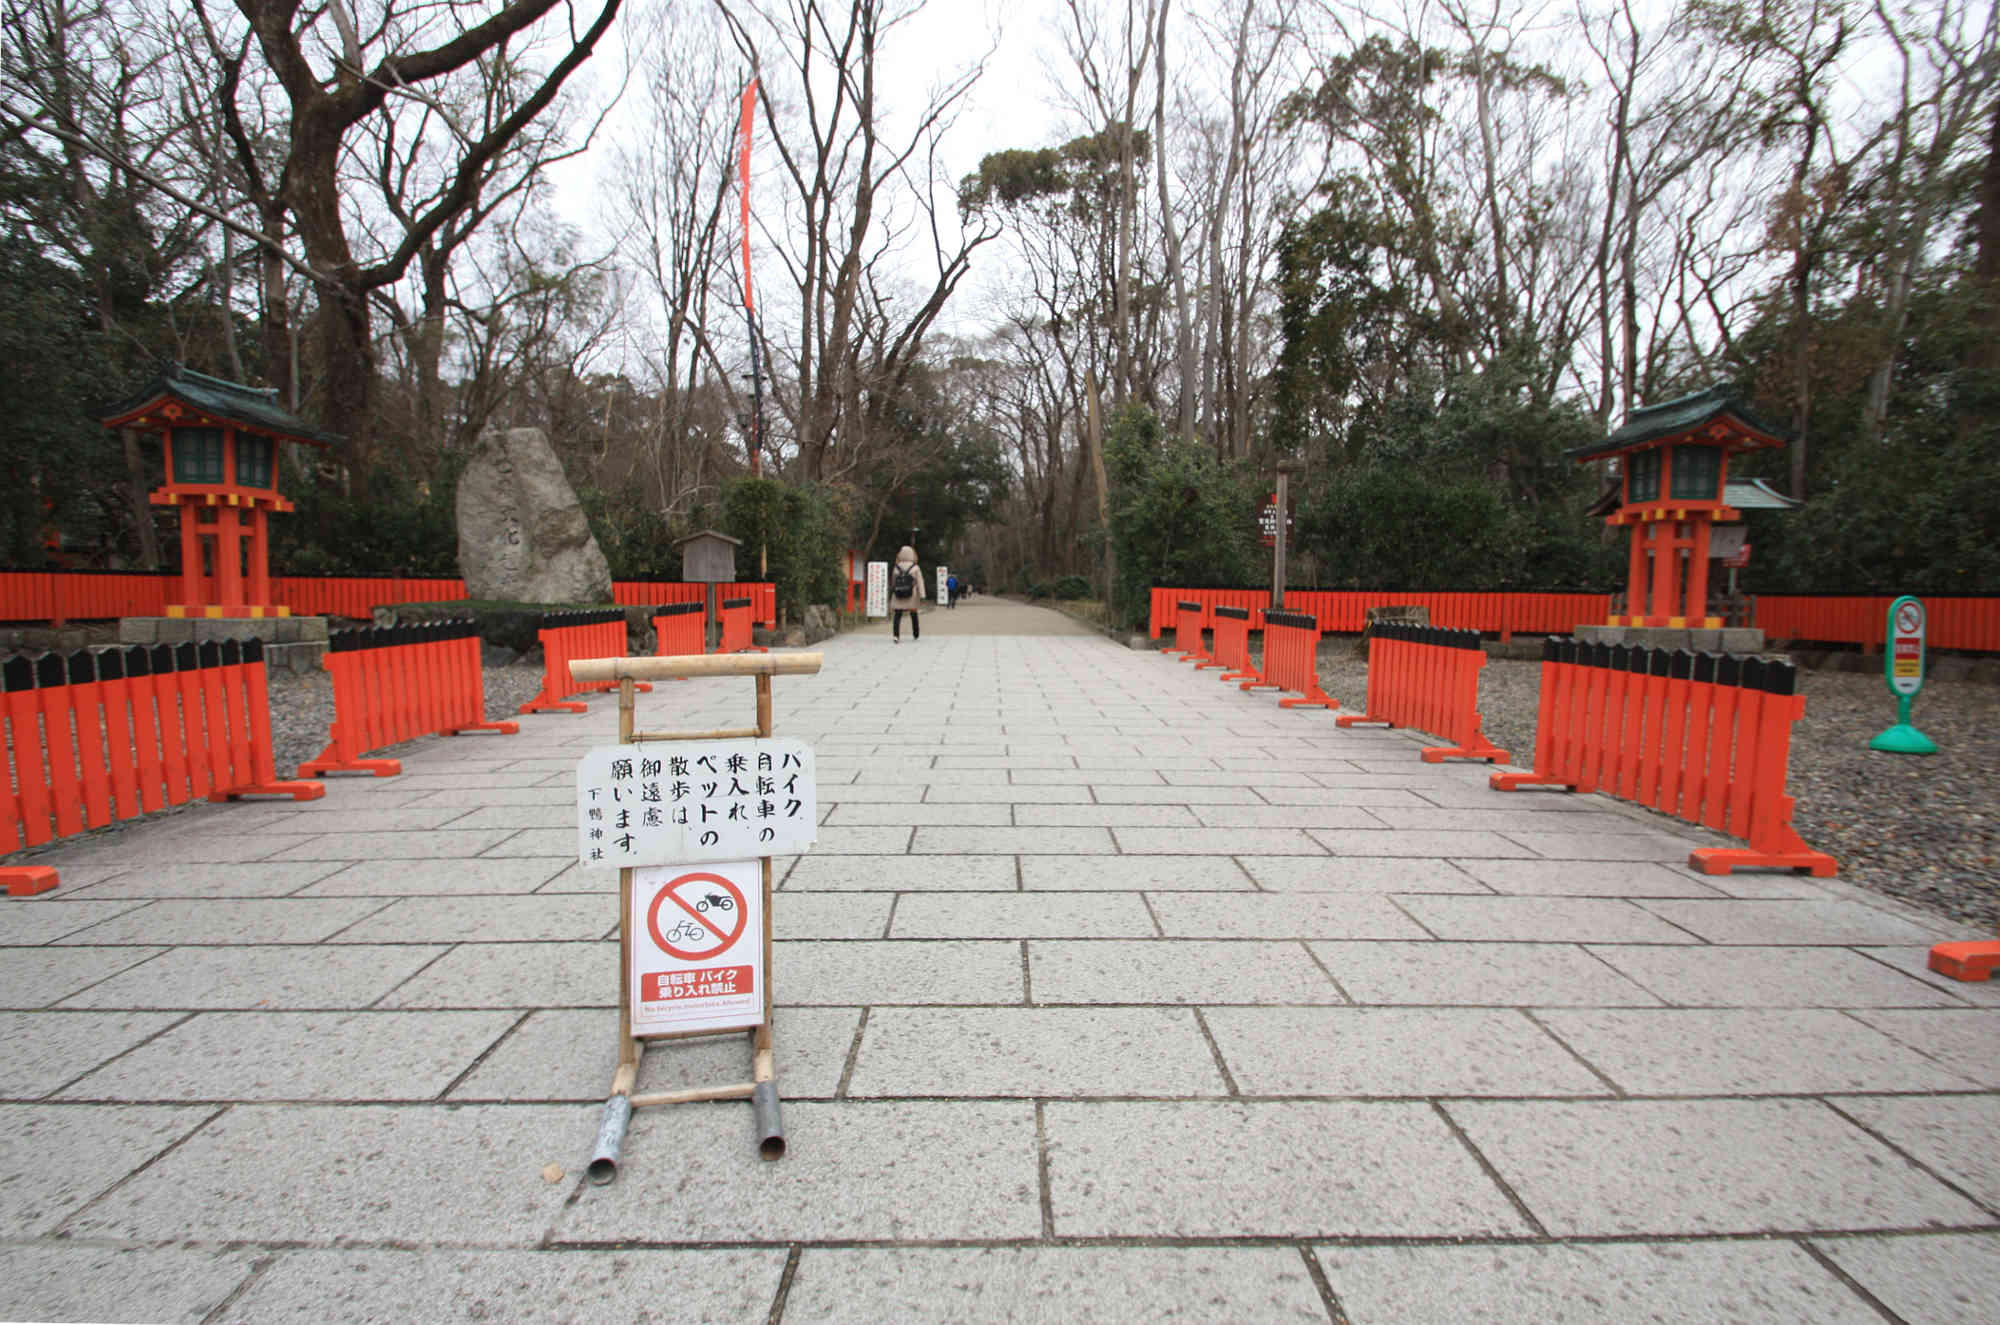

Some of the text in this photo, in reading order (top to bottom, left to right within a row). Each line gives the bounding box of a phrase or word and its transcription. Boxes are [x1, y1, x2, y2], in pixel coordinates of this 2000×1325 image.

[640, 757, 663, 827] 御遠慮
[696, 754, 719, 845] ペットの
[755, 752, 775, 842] 自転車の
[700, 969, 737, 982] バイク
